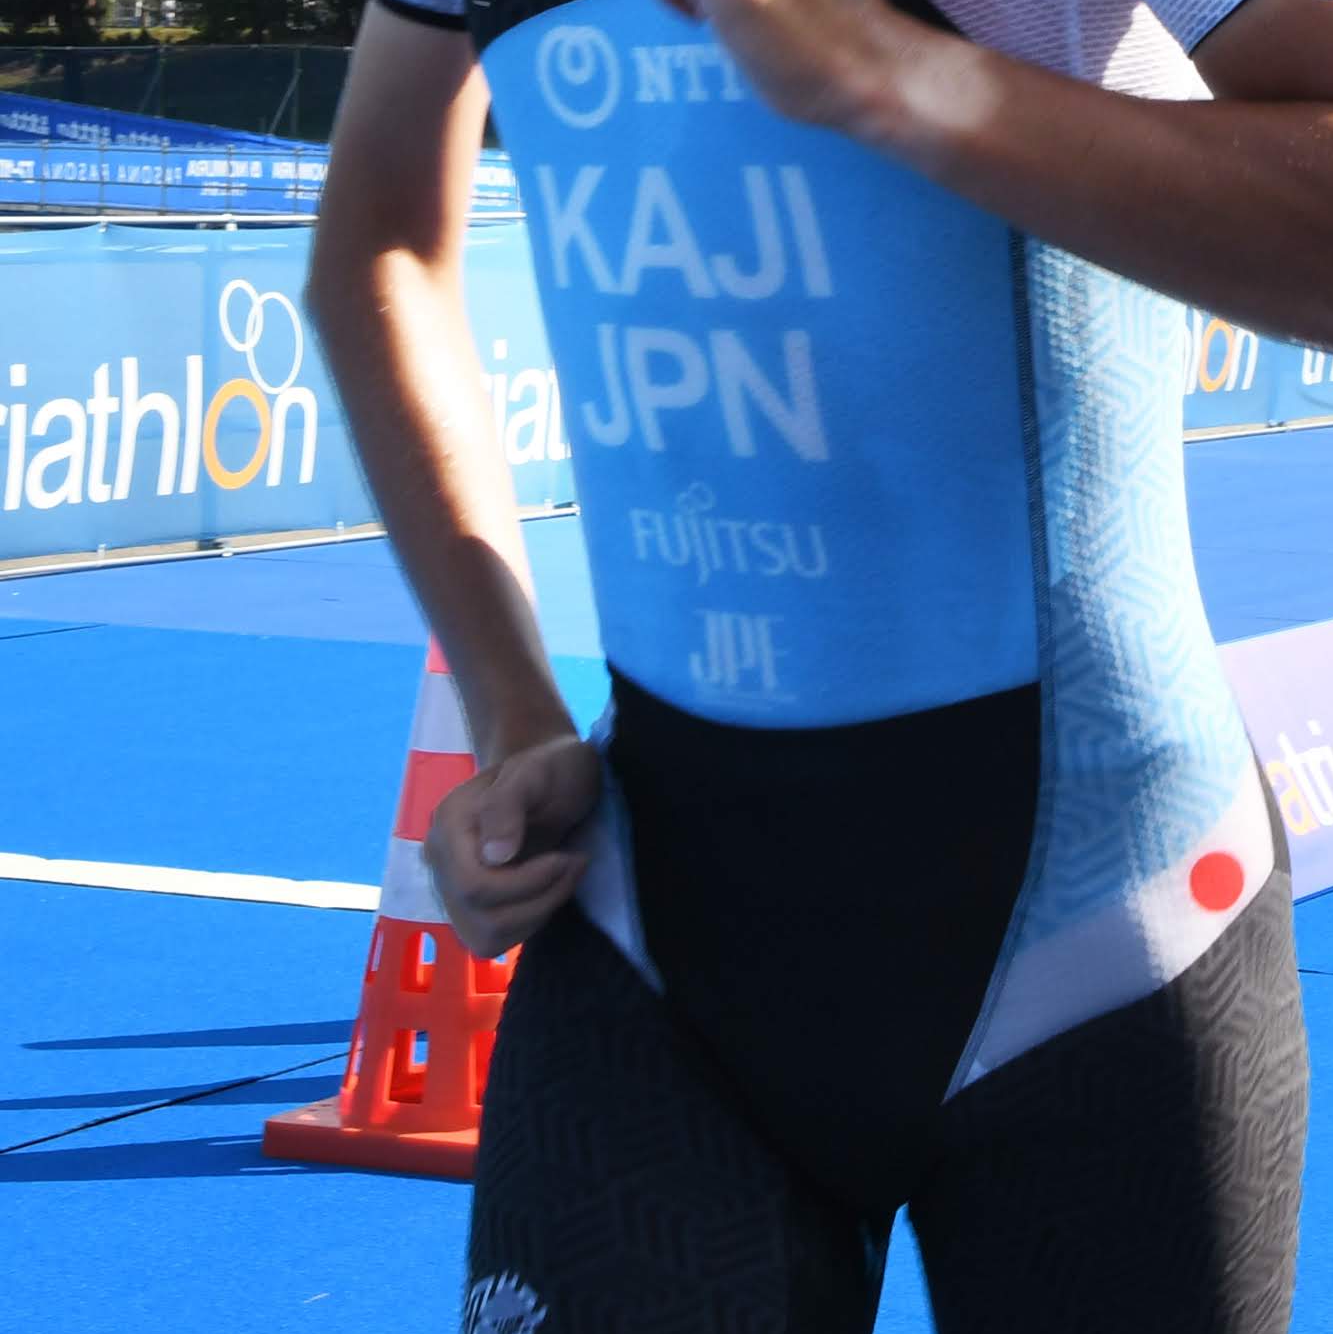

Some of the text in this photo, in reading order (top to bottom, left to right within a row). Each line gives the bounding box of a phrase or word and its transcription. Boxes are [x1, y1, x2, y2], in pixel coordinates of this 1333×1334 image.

[535, 163, 834, 300] KAJI
[581, 322, 831, 462] JPN
[628, 505, 828, 587] FUJITSU
